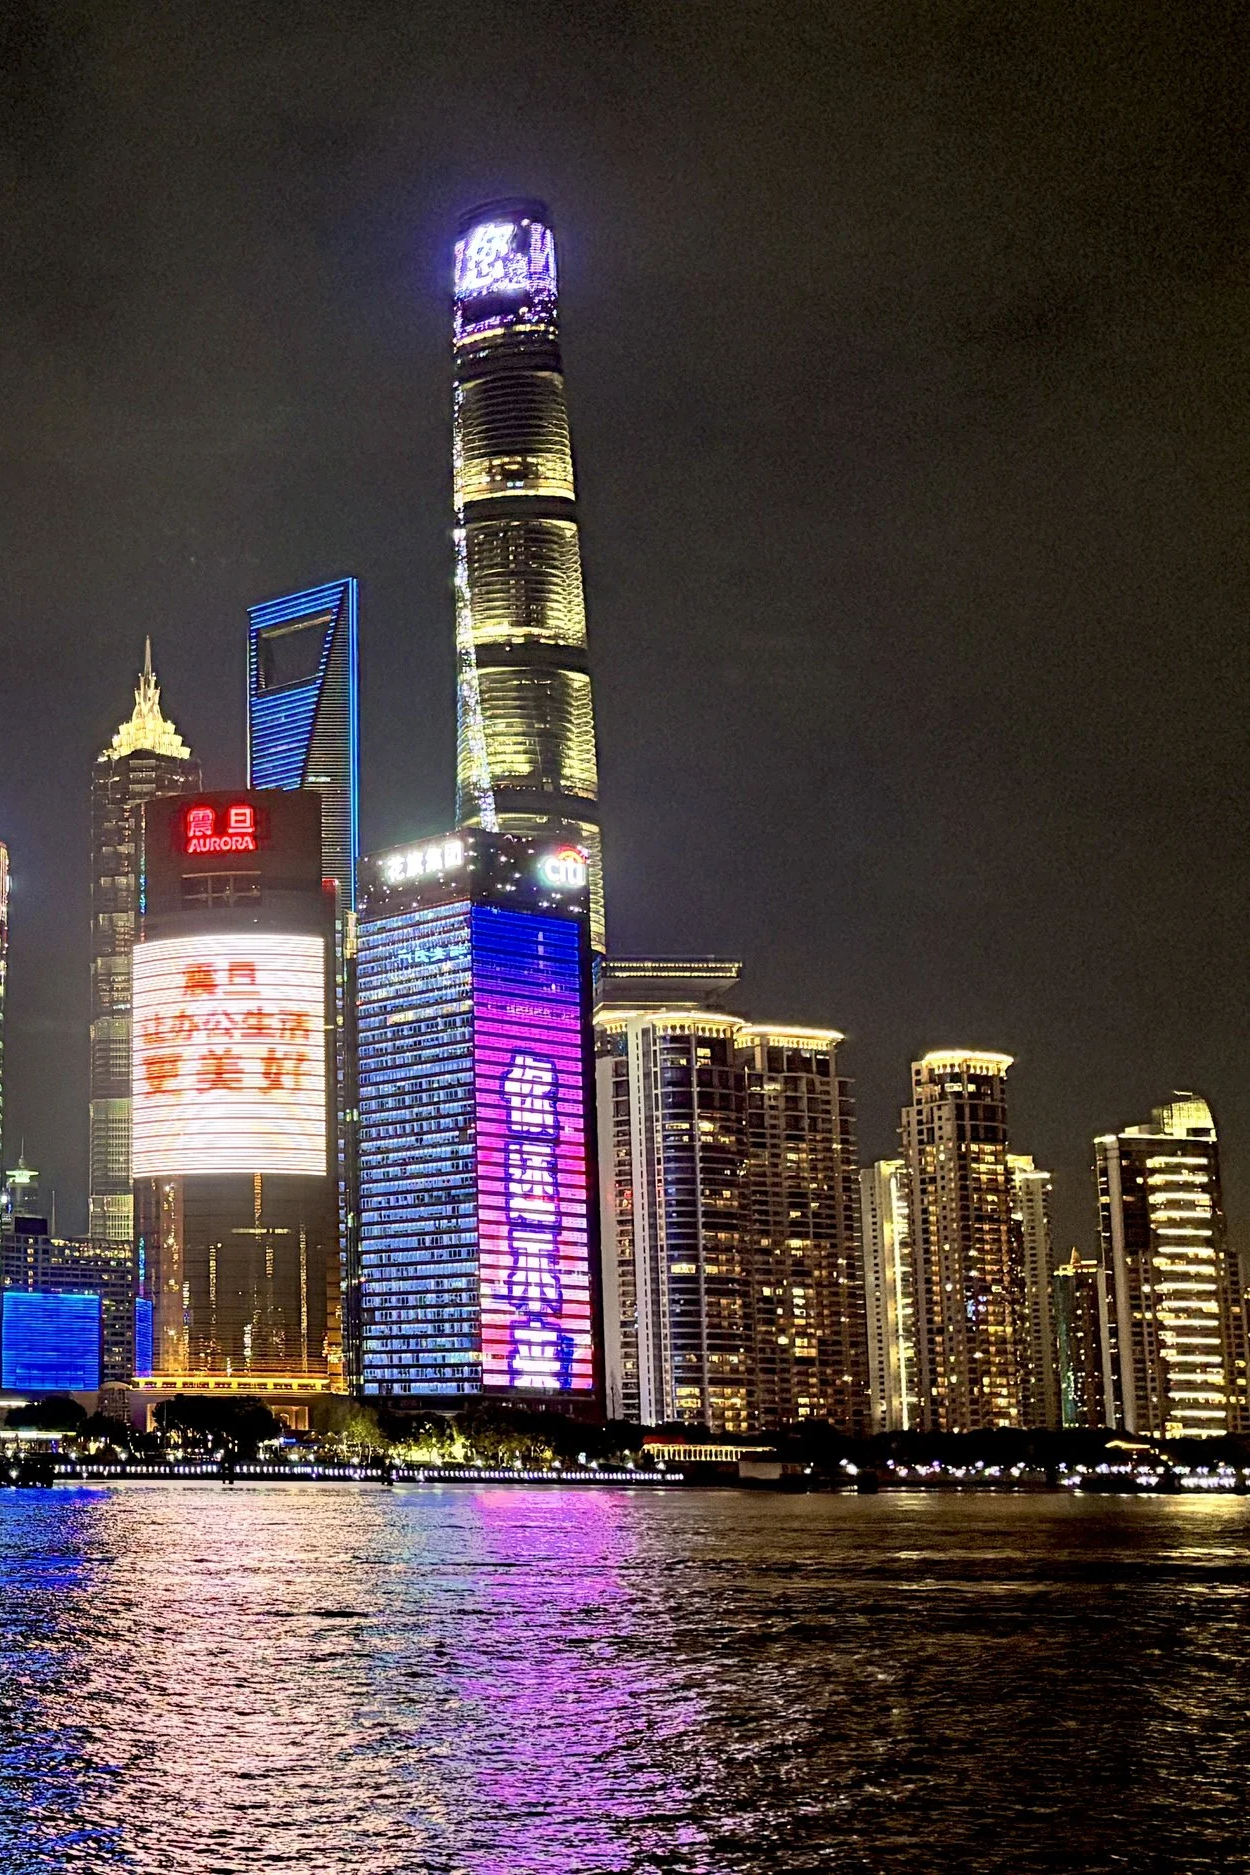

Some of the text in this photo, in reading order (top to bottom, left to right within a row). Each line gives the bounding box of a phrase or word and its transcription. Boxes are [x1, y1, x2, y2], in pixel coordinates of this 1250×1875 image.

[186, 806, 255, 836] 震旦
[188, 836, 256, 854] AURORA
[545, 857, 585, 885] citi
[182, 962, 261, 998] 震旦
[141, 1047, 310, 1098] 更美好
